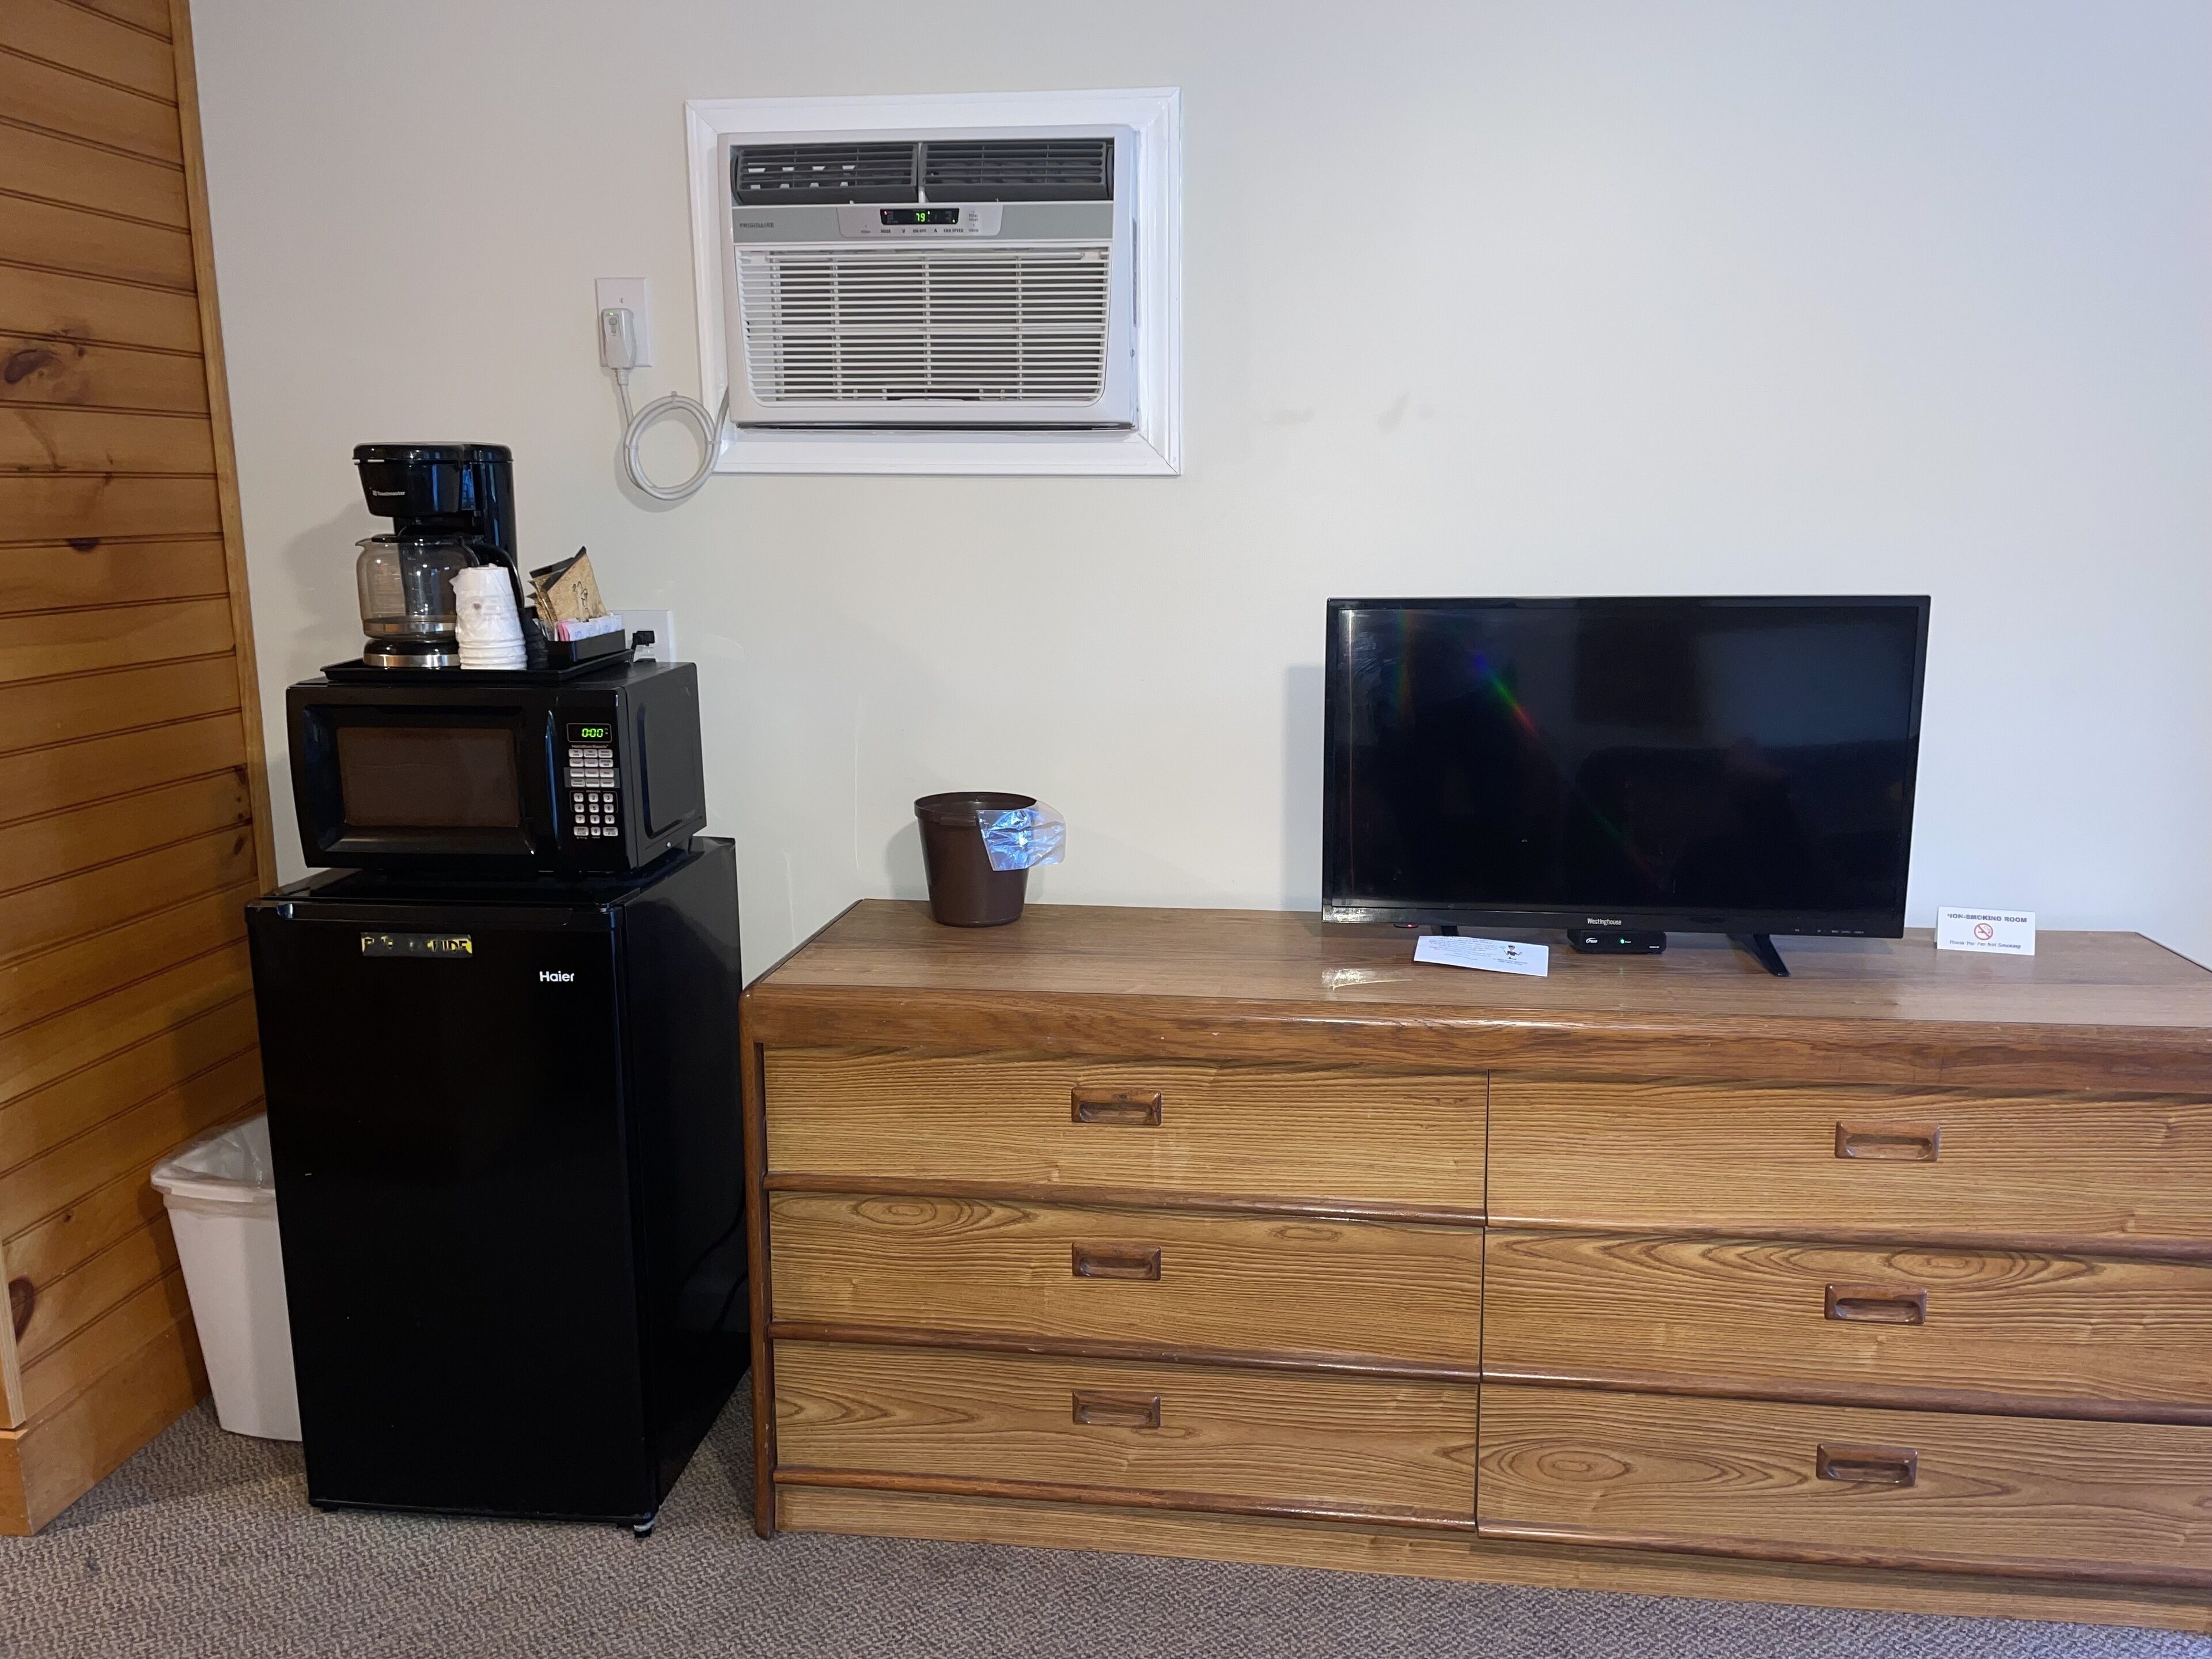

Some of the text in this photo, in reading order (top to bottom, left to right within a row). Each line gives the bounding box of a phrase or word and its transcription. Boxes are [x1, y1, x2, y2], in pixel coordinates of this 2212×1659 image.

[915, 213, 926, 222] 79
[581, 728, 604, 737] 0:00
[1587, 918, 1622, 926] Westinghouse
[1947, 914, 2002, 922] NON-SMOKING
[539, 971, 575, 982] Haier
